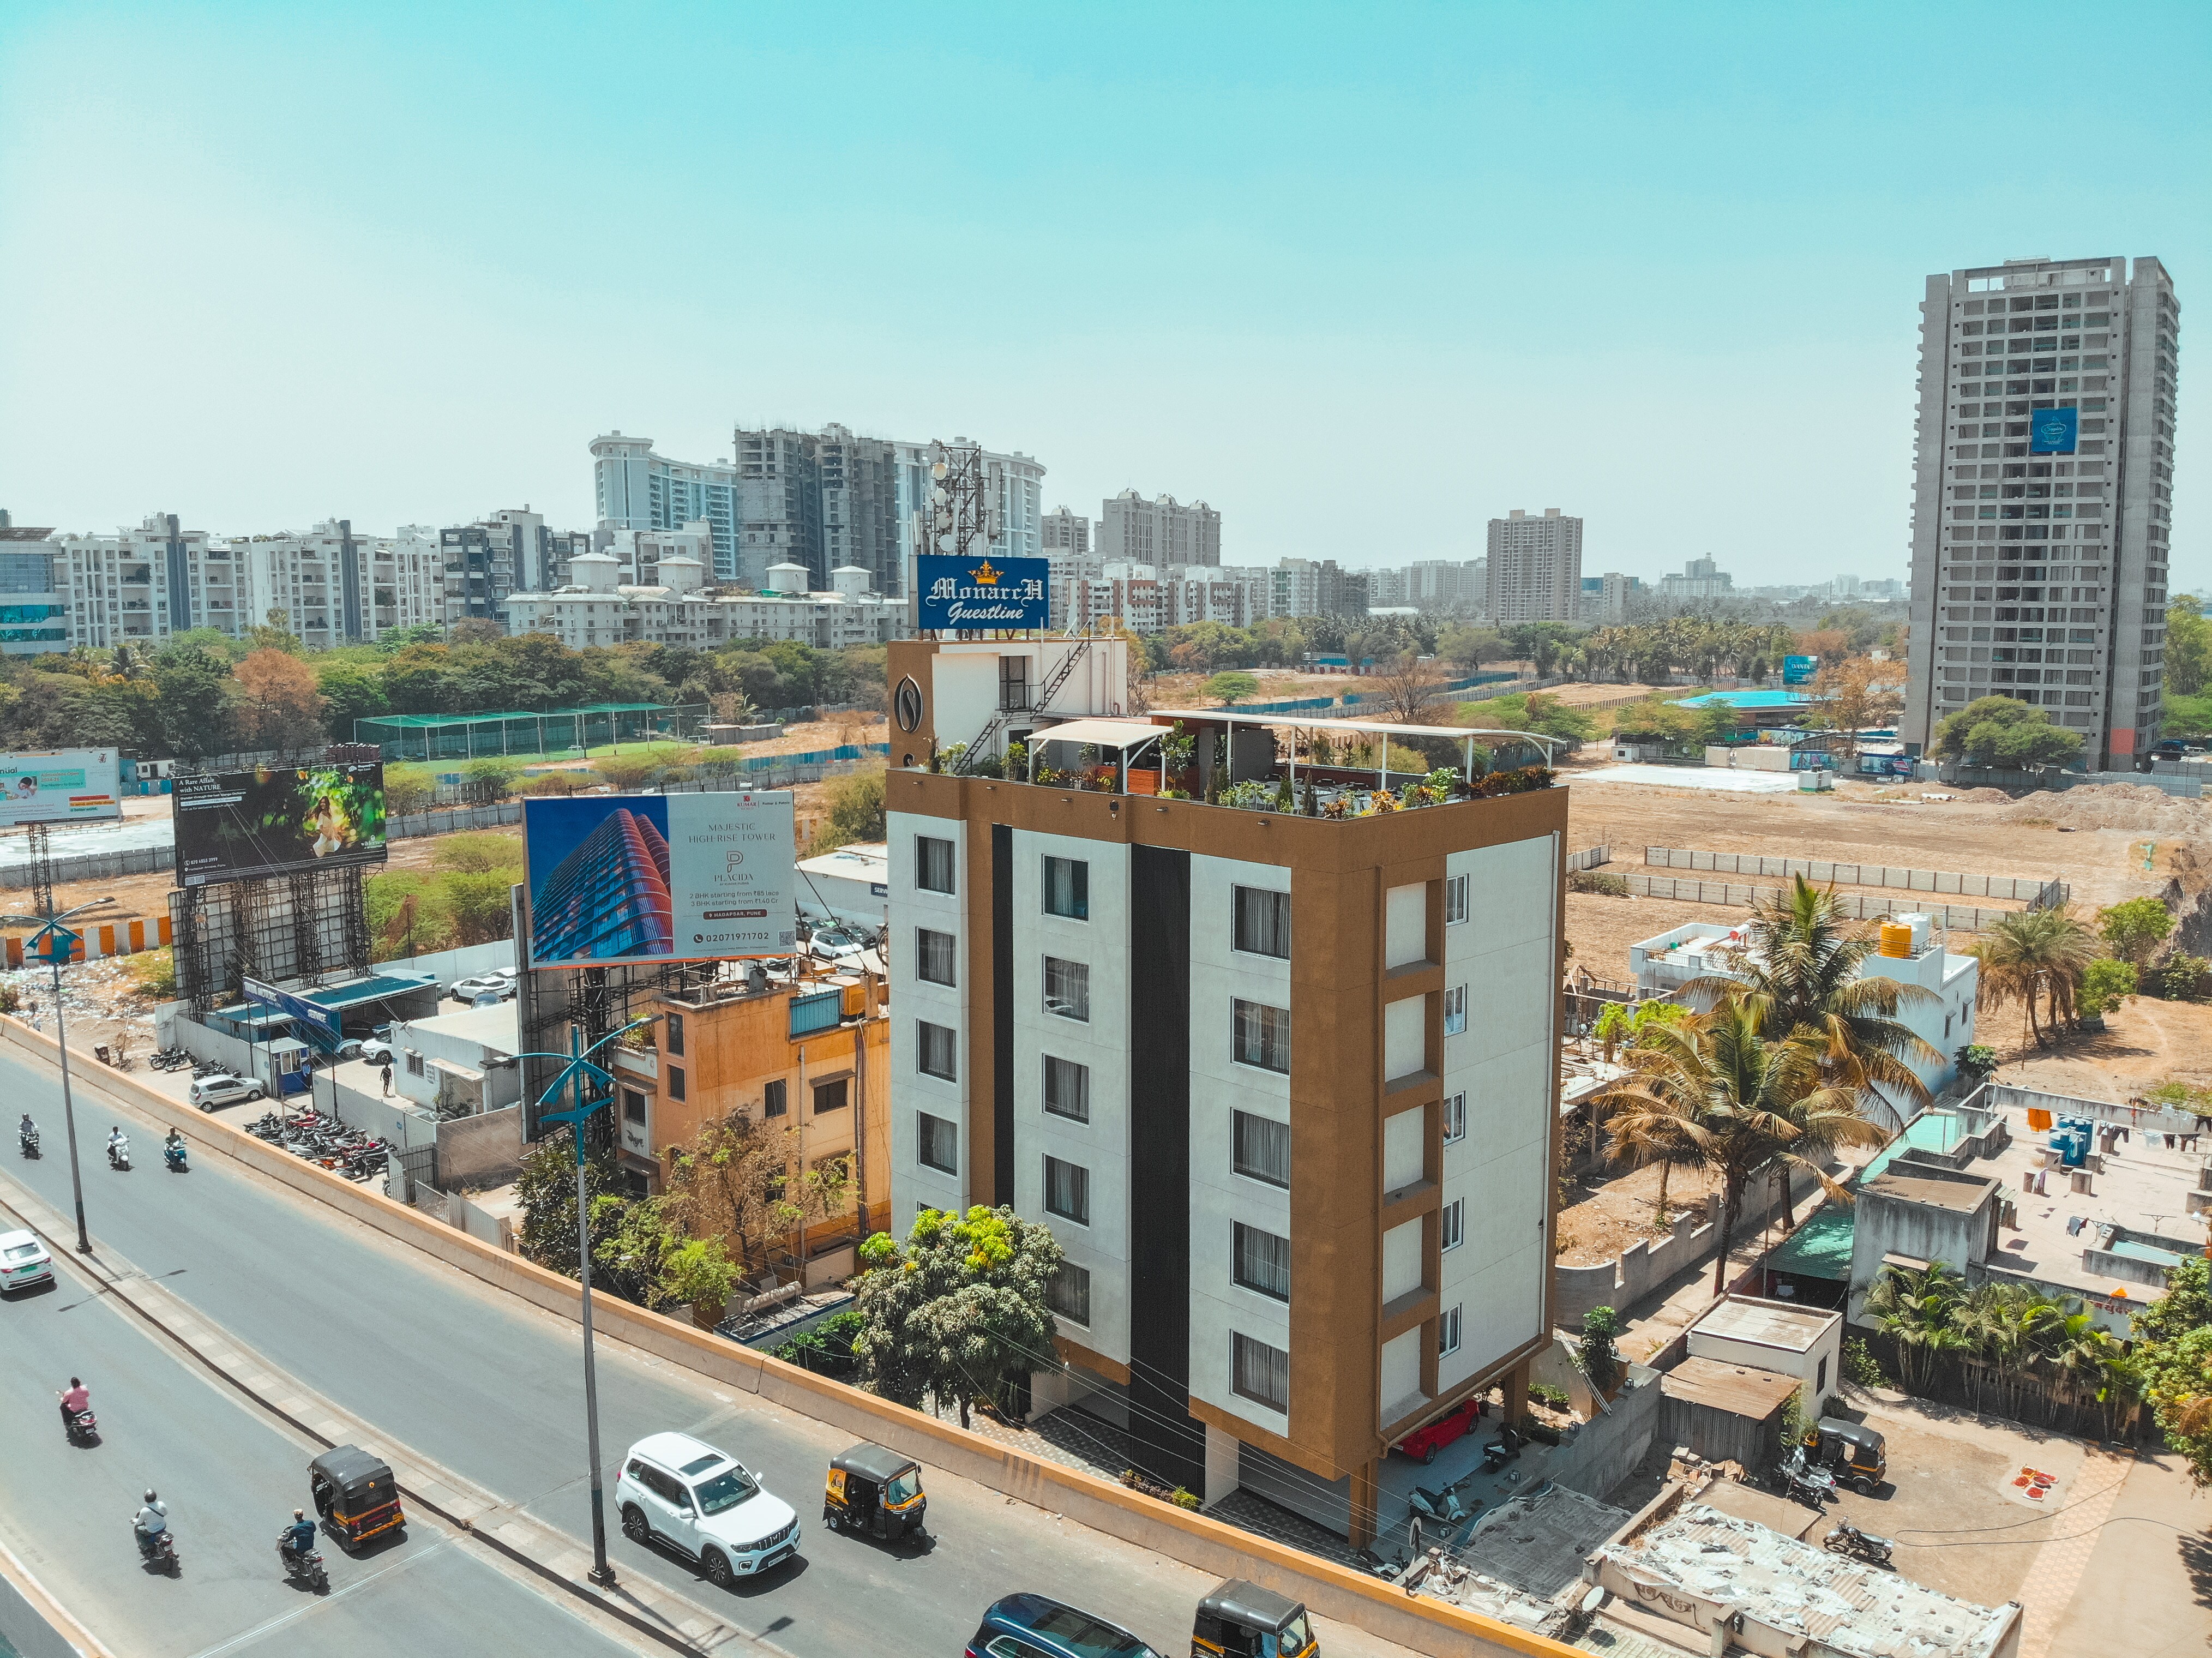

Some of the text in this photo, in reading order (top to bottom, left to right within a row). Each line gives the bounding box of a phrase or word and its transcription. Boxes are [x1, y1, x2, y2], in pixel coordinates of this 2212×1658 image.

[947, 601, 1024, 625] Guestline
[709, 823, 755, 832] MAJESTIC
[689, 833, 776, 843] HIGH-RISE TOWER
[714, 873, 754, 882] PLACIDA
[706, 932, 769, 942] 02071971702
[307, 1009, 327, 1023] SERVICE
